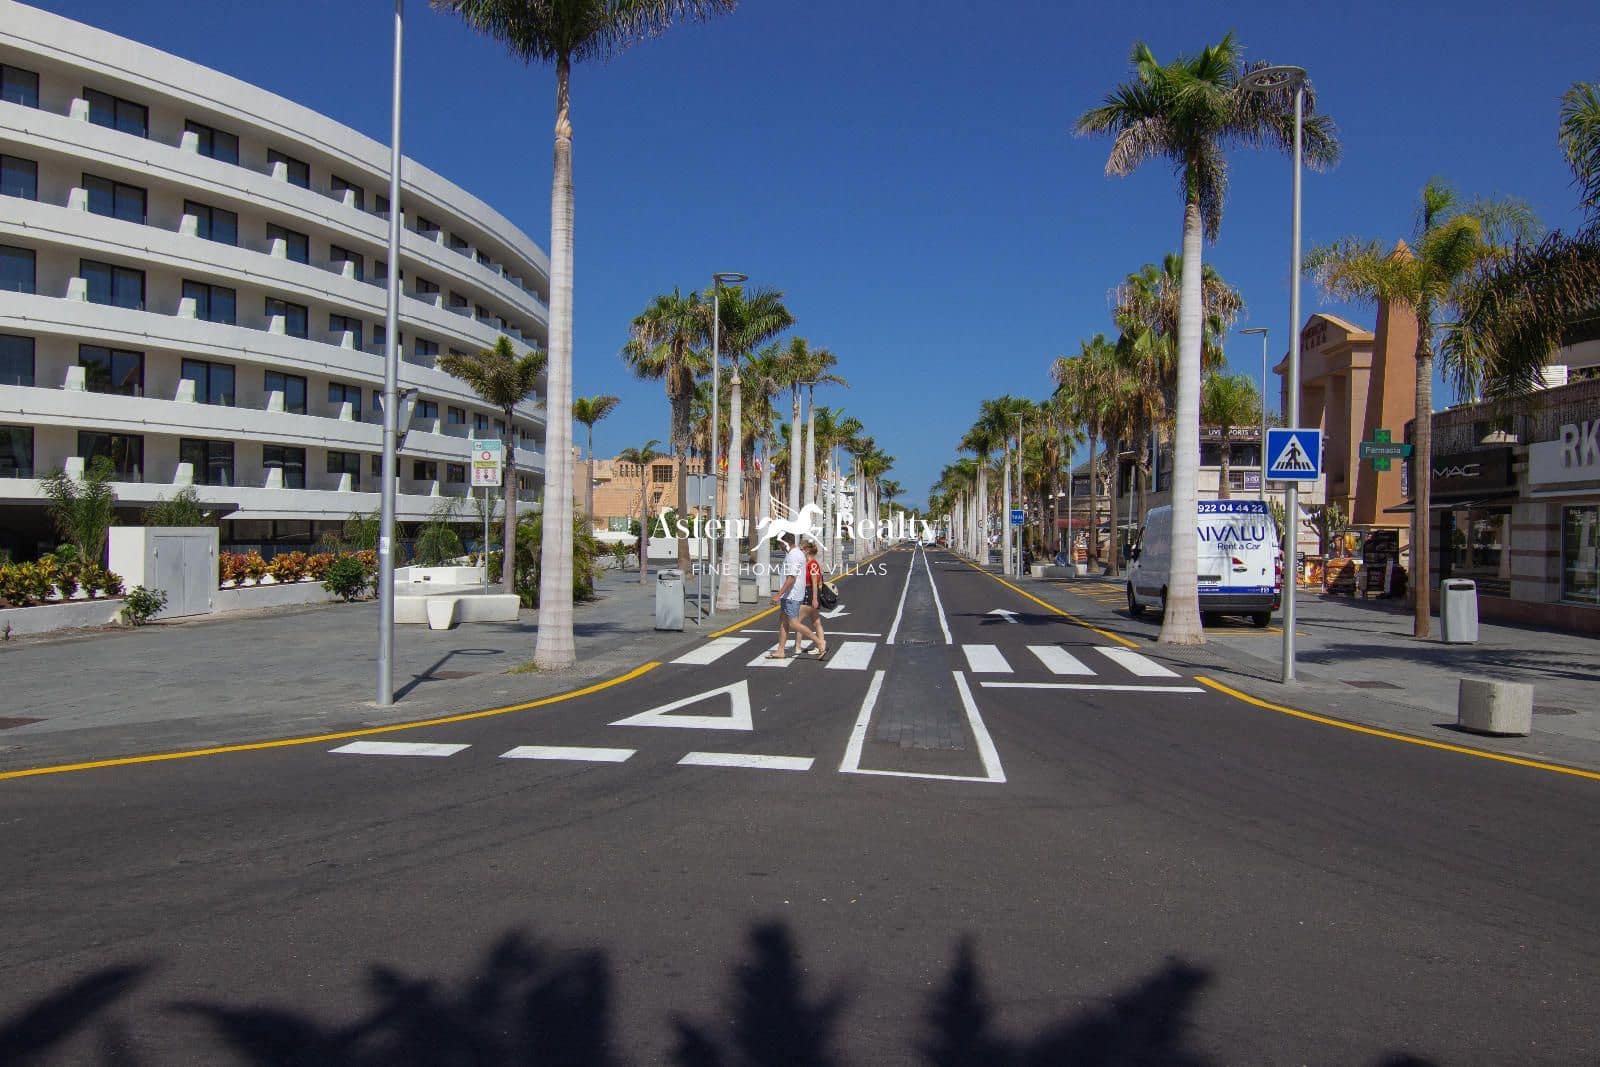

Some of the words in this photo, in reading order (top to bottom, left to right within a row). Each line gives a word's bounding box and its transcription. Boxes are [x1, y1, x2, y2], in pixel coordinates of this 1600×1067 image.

[1365, 446, 1401, 455] Farmacia
[1198, 504, 1217, 513] 922
[1219, 504, 1233, 513] 04
[1236, 504, 1249, 512] 44
[1251, 504, 1264, 513] 22
[1218, 543, 1236, 551] Rent
[1246, 543, 1261, 551] Car
